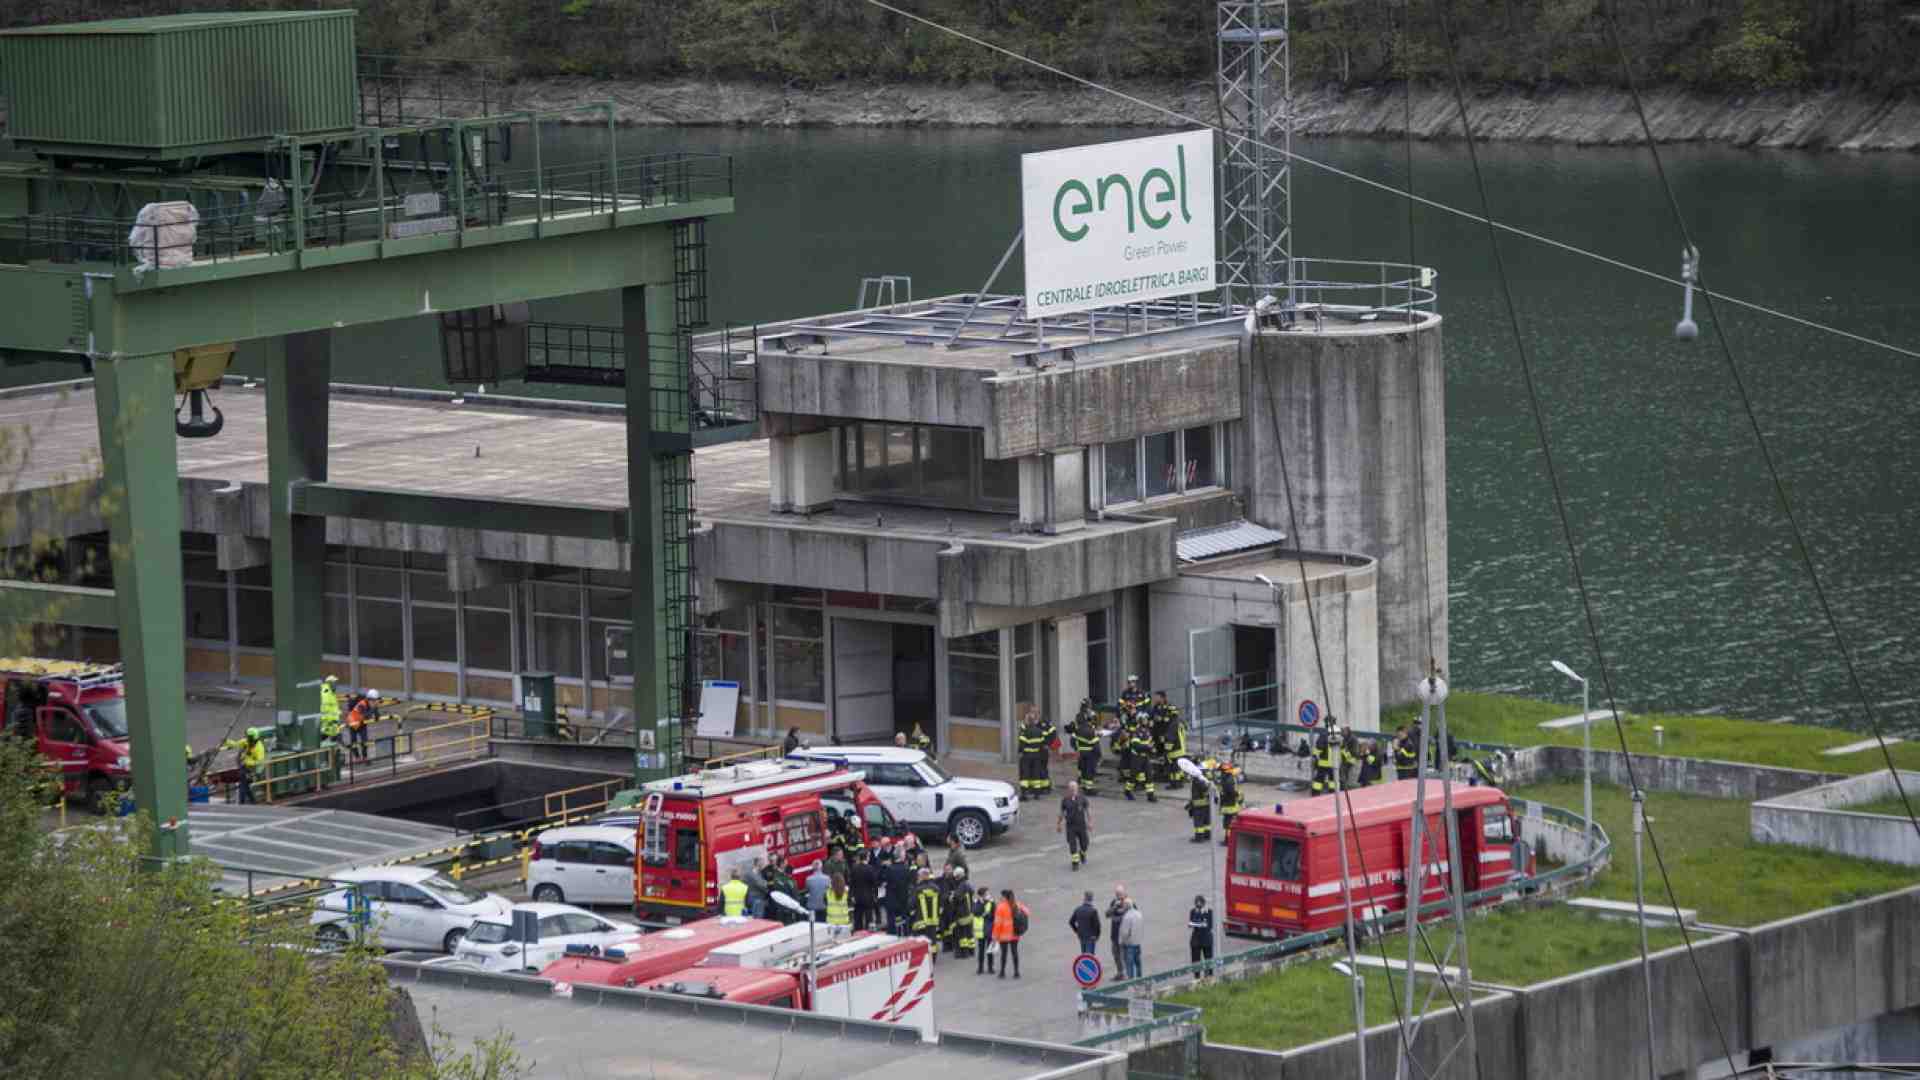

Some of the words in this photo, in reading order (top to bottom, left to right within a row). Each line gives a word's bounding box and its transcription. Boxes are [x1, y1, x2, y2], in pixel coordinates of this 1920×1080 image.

[1053, 144, 1192, 242] enel
[1123, 244, 1155, 261] Green
[1157, 240, 1188, 257] Power
[1037, 284, 1092, 306] CENTRALE
[1095, 271, 1176, 298] IDROELETTRICA
[1178, 266, 1209, 284] BARGI
